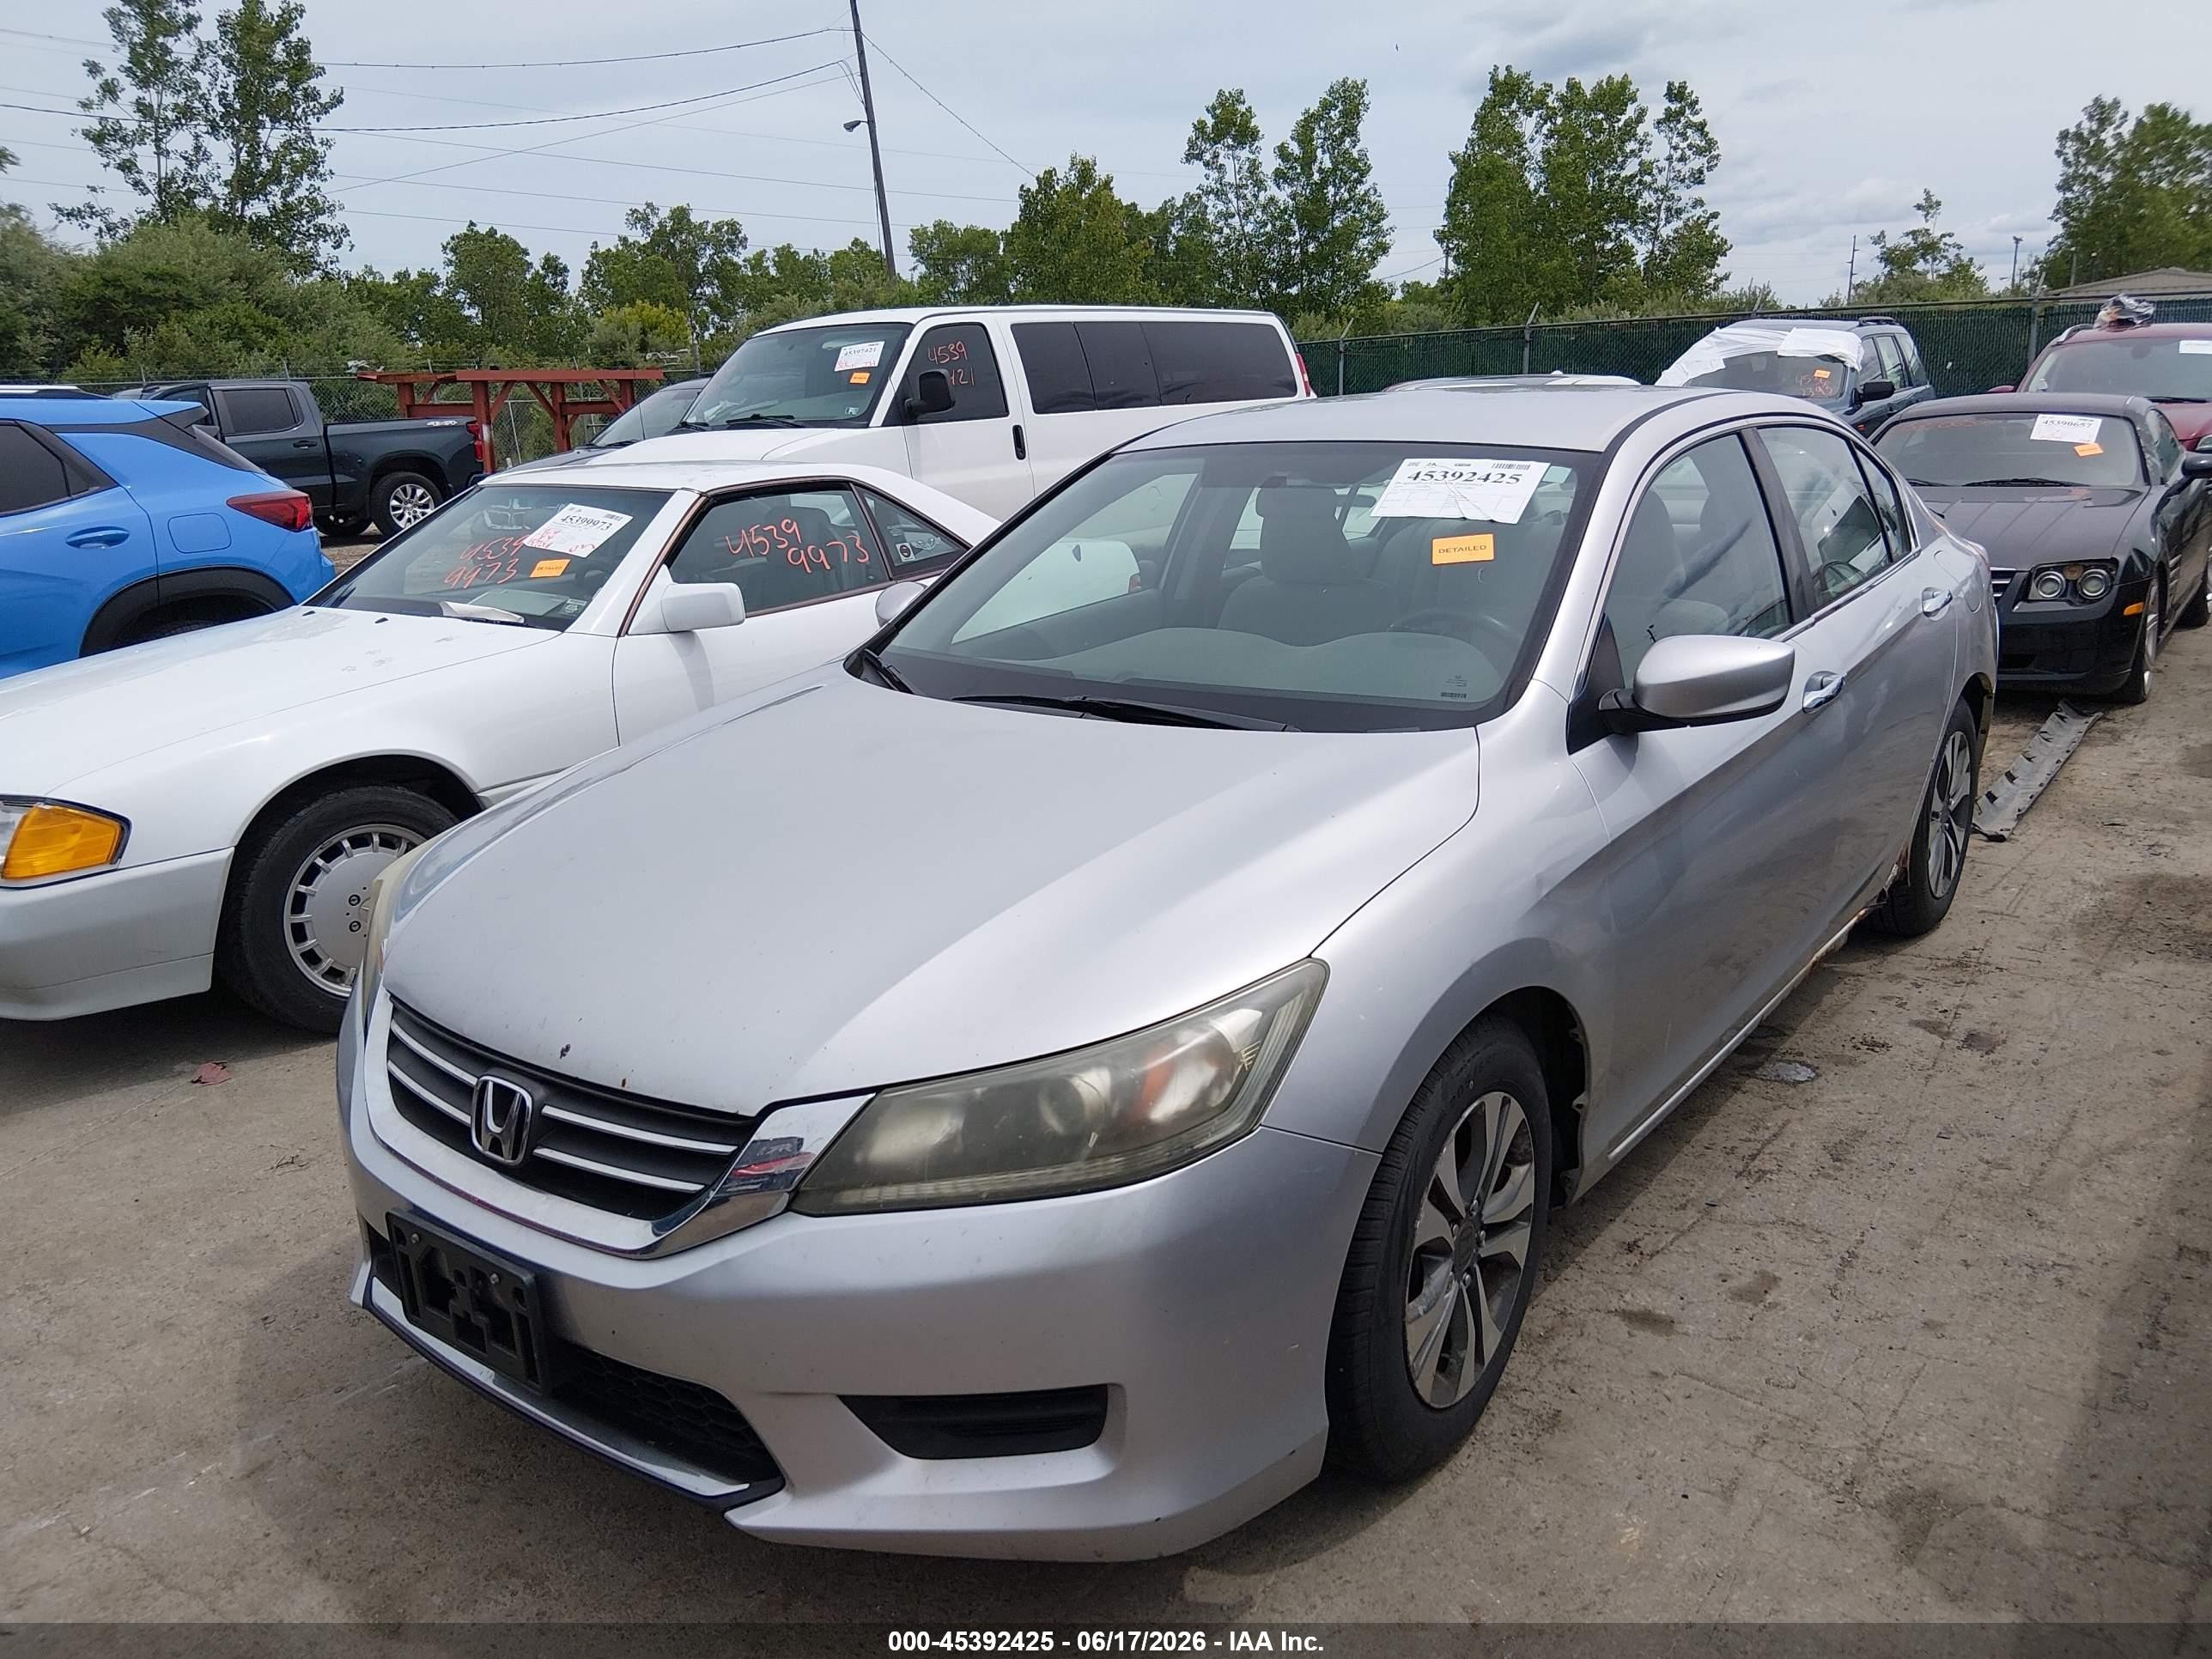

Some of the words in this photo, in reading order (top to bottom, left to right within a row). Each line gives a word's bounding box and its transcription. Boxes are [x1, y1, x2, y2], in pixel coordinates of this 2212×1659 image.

[927, 341, 968, 365] 4539
[1407, 471, 1522, 484] 45392425
[560, 514, 612, 531] 45399973
[459, 534, 529, 561] 4539
[725, 518, 802, 557] 4539
[1438, 544, 1487, 554] DETAILED
[787, 535, 871, 574] 9973
[443, 557, 520, 590] 9973
